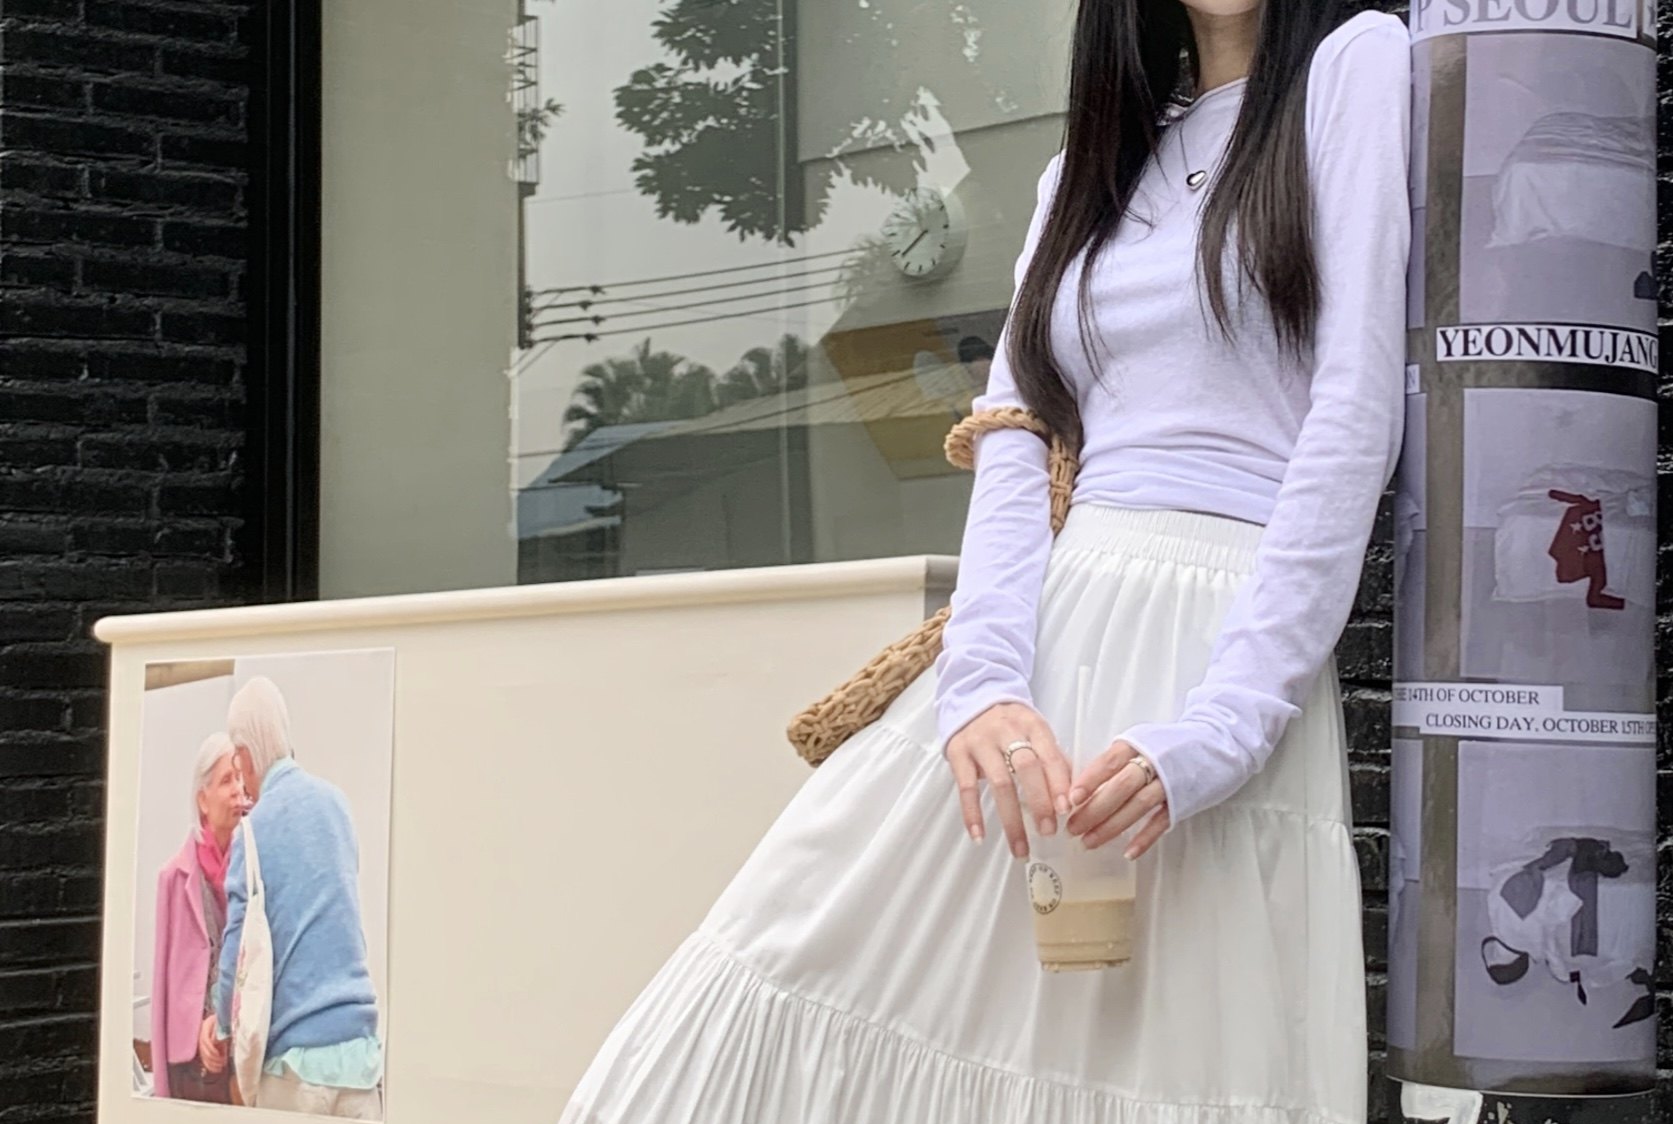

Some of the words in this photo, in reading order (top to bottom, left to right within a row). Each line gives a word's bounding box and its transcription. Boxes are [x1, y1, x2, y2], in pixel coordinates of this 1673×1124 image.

[1443, 0, 1633, 28] SEOUL
[1439, 327, 1657, 369] YEONMUJANG
[1436, 687, 1456, 702] OF
[1458, 688, 1540, 705] OCTOBER
[1425, 713, 1492, 730] CLOSING
[1542, 717, 1618, 734] OCTOBER
